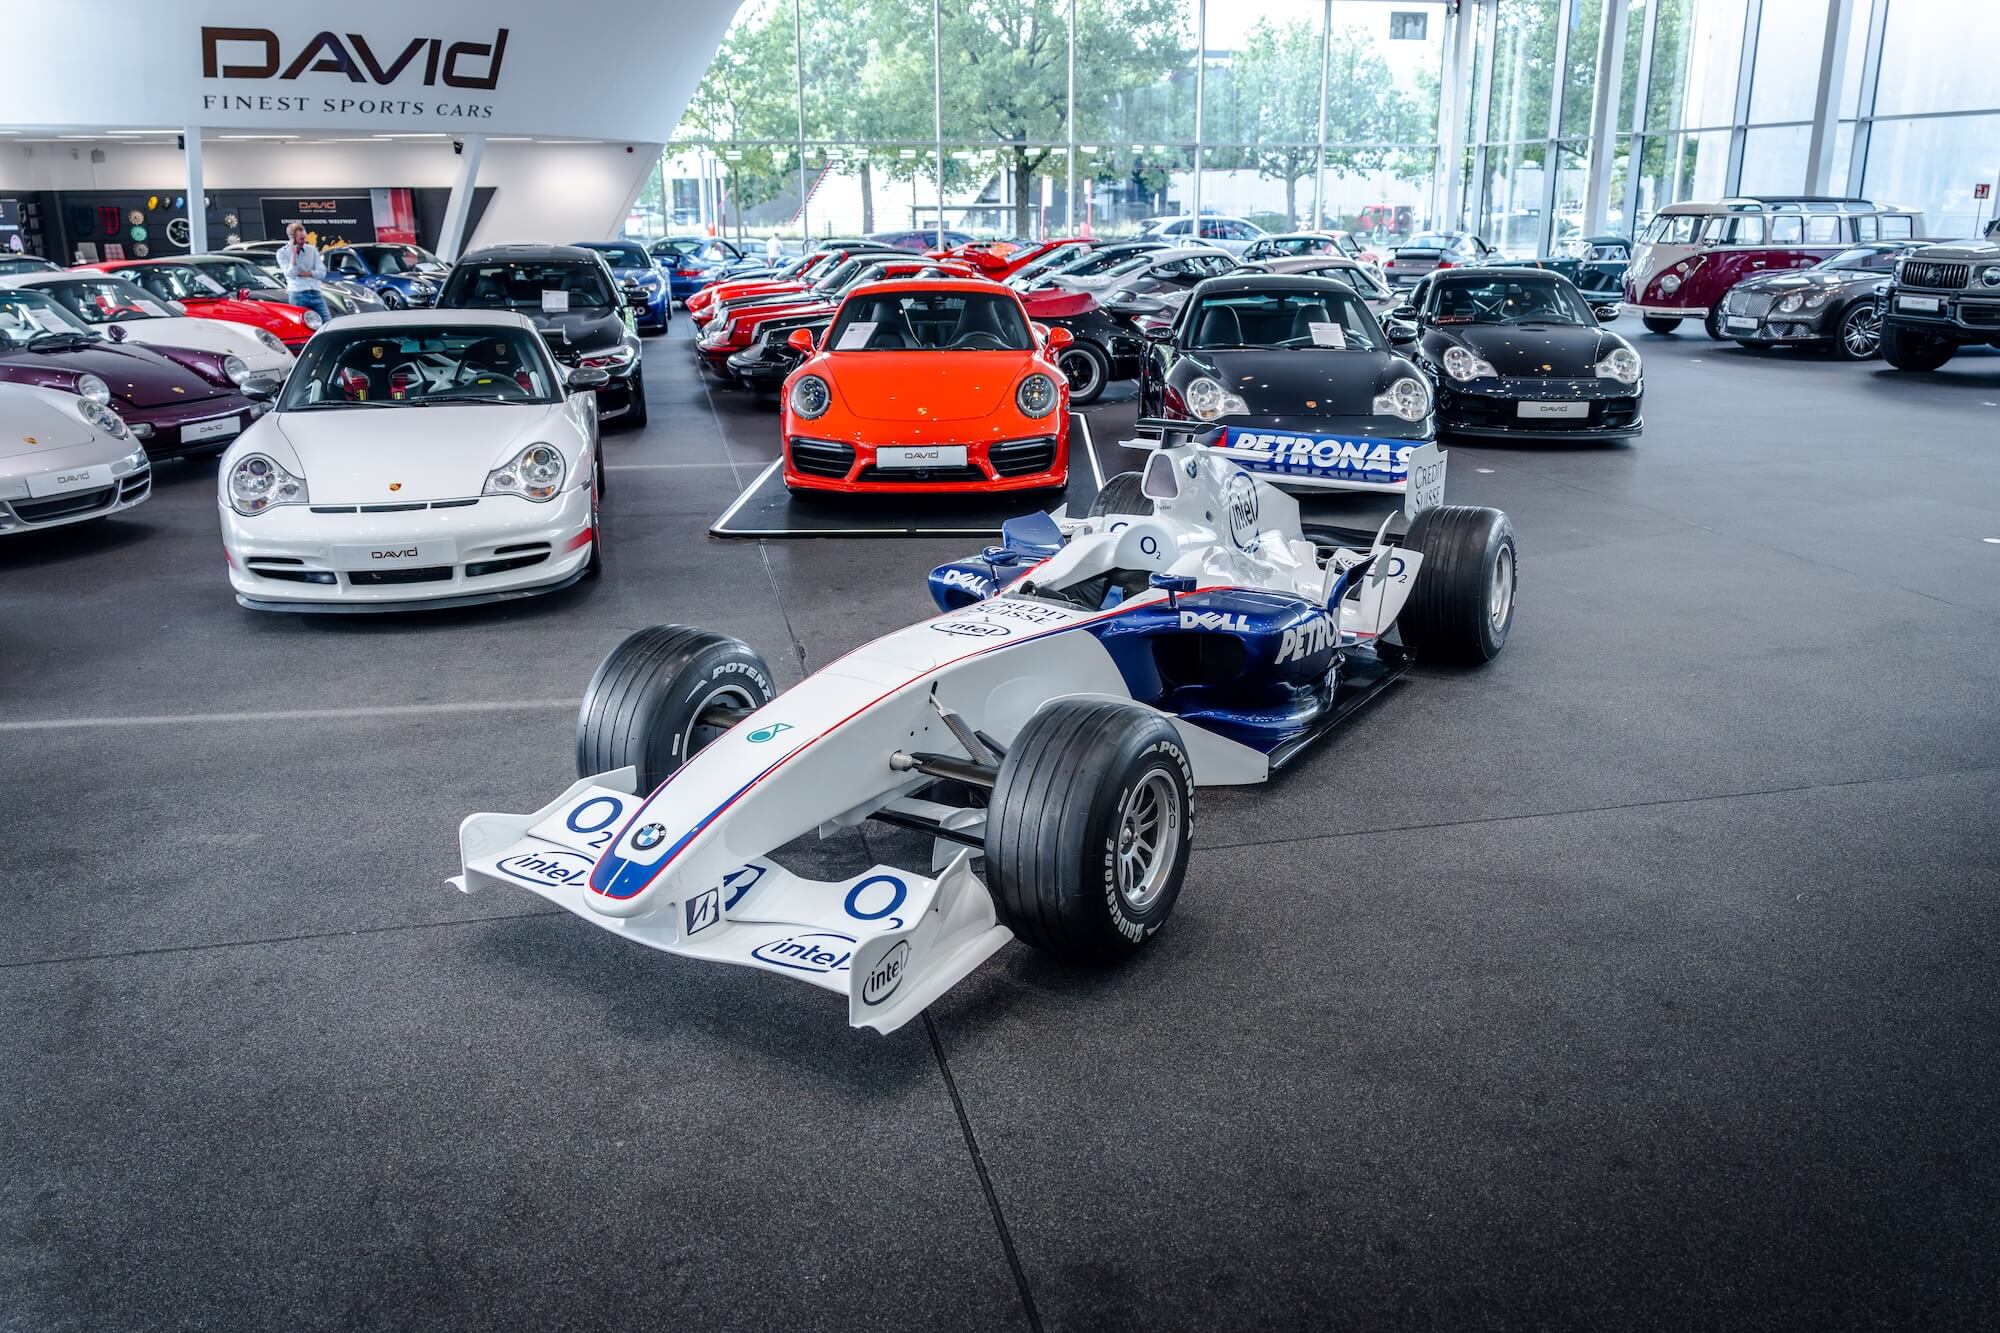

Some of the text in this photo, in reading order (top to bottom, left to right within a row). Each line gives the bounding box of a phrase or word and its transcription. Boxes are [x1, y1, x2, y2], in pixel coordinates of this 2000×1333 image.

[203, 95, 493, 118] FINEST SPORTS CARS
[1234, 433, 1415, 473] PETRONAS
[1415, 460, 1444, 489] CREDIT
[1232, 489, 1256, 530] intel
[1180, 611, 1250, 631] DELL
[712, 662, 772, 703] POTENZ
[1159, 741, 1195, 840] POTENZA
[514, 853, 585, 883] intel
[1105, 838, 1145, 944] BRIDGESTONE
[770, 938, 851, 968] intel
[870, 950, 905, 993] intel
